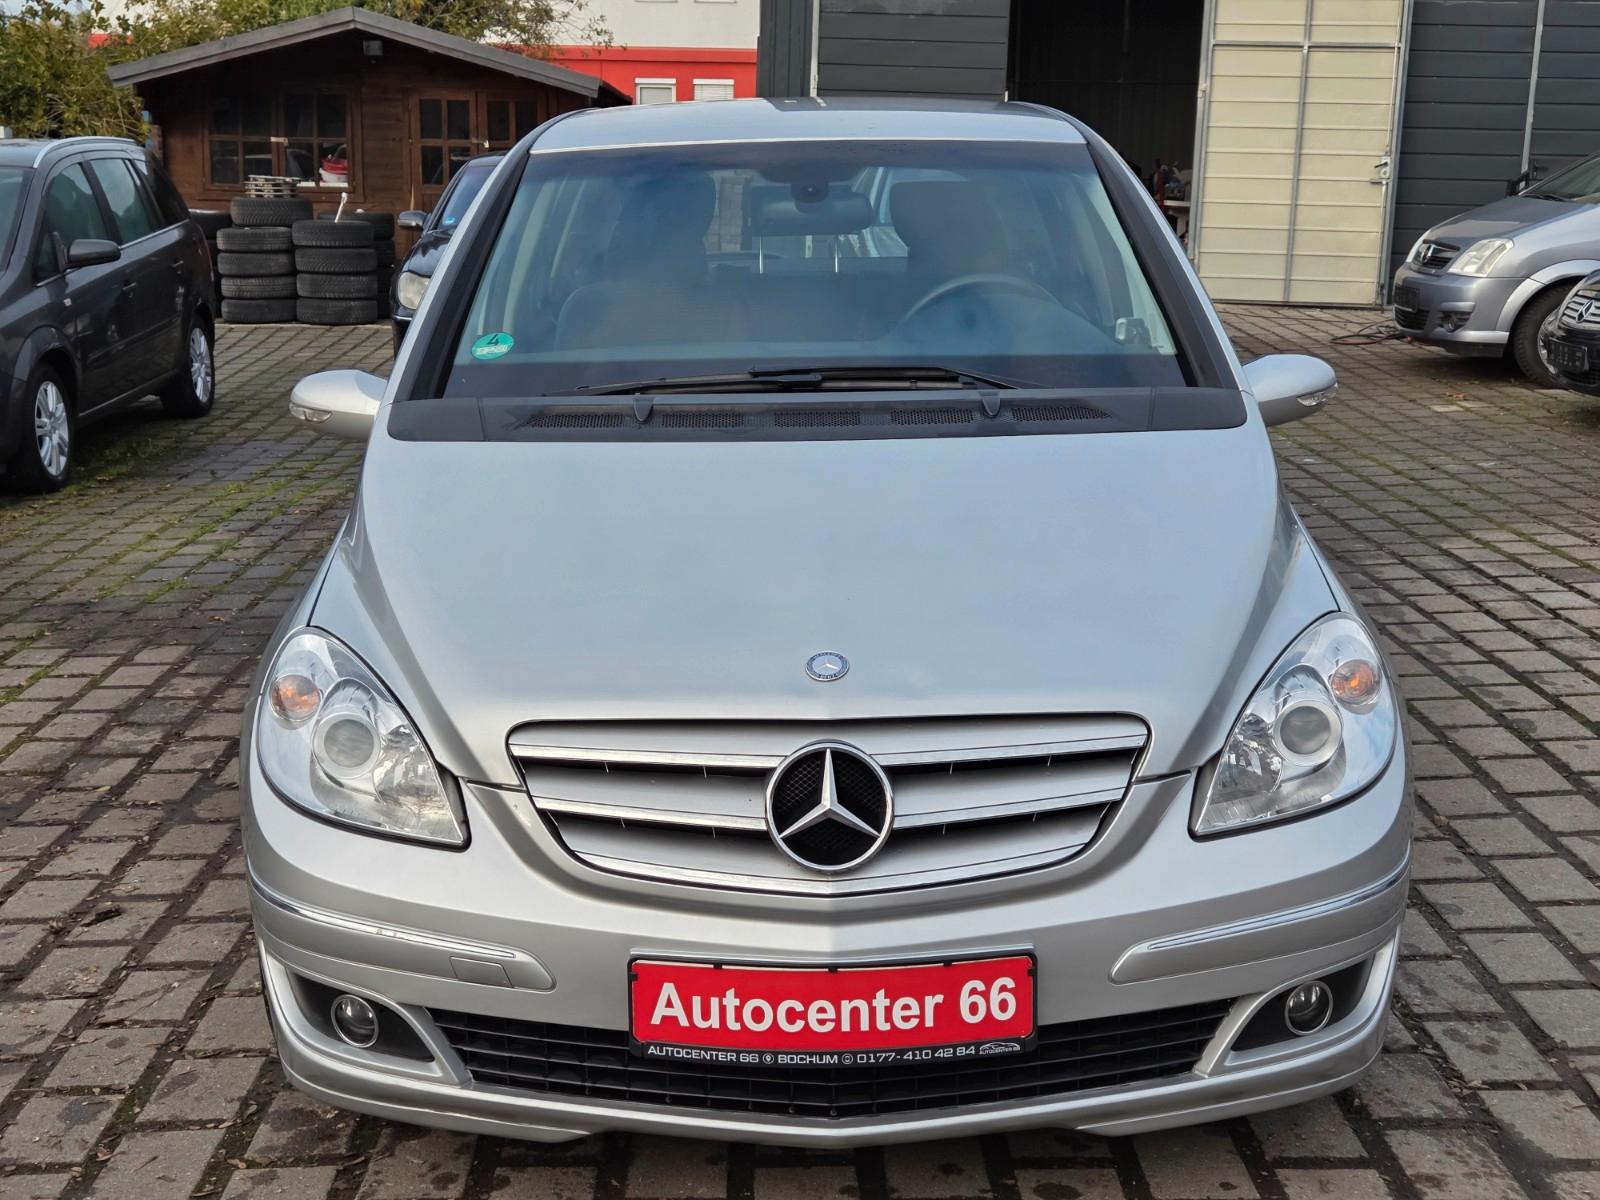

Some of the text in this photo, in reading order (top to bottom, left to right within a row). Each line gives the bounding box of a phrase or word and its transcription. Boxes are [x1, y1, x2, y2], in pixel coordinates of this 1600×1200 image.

[650, 976, 1017, 1033] Autocenter 66
[647, 1045, 737, 1062] AUTOCENTER
[739, 1053, 759, 1063] 66
[777, 1053, 838, 1064] BOCHUM
[934, 1047, 953, 1058] 42
[956, 1045, 976, 1056] 84
